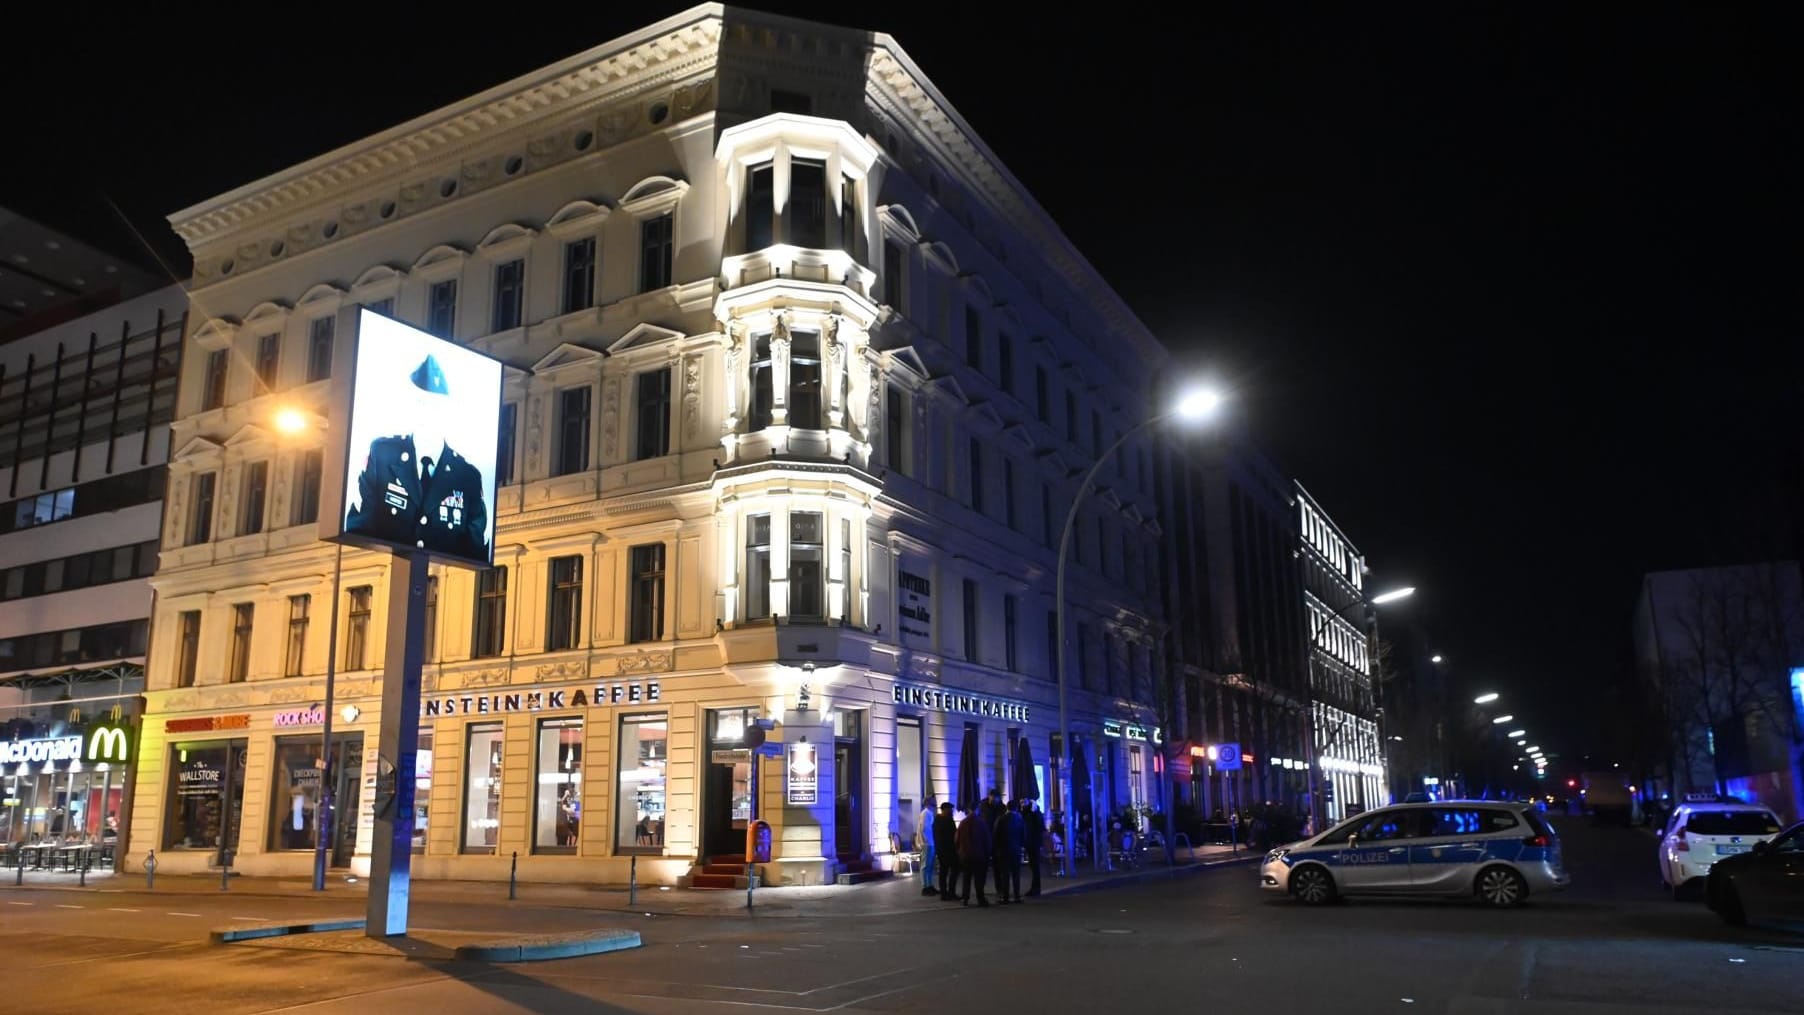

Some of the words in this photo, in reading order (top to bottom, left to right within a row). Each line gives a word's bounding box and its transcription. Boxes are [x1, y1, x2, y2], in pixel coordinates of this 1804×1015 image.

[424, 694, 522, 717] NSTEIN
[548, 682, 661, 709] KAFFEE
[893, 684, 968, 712] EINSTEIN
[980, 699, 1031, 722] KAFFEE
[274, 712, 301, 727] ROCK
[179, 770, 220, 783] WALLSTORE
[1343, 851, 1390, 864] POLIZEI
